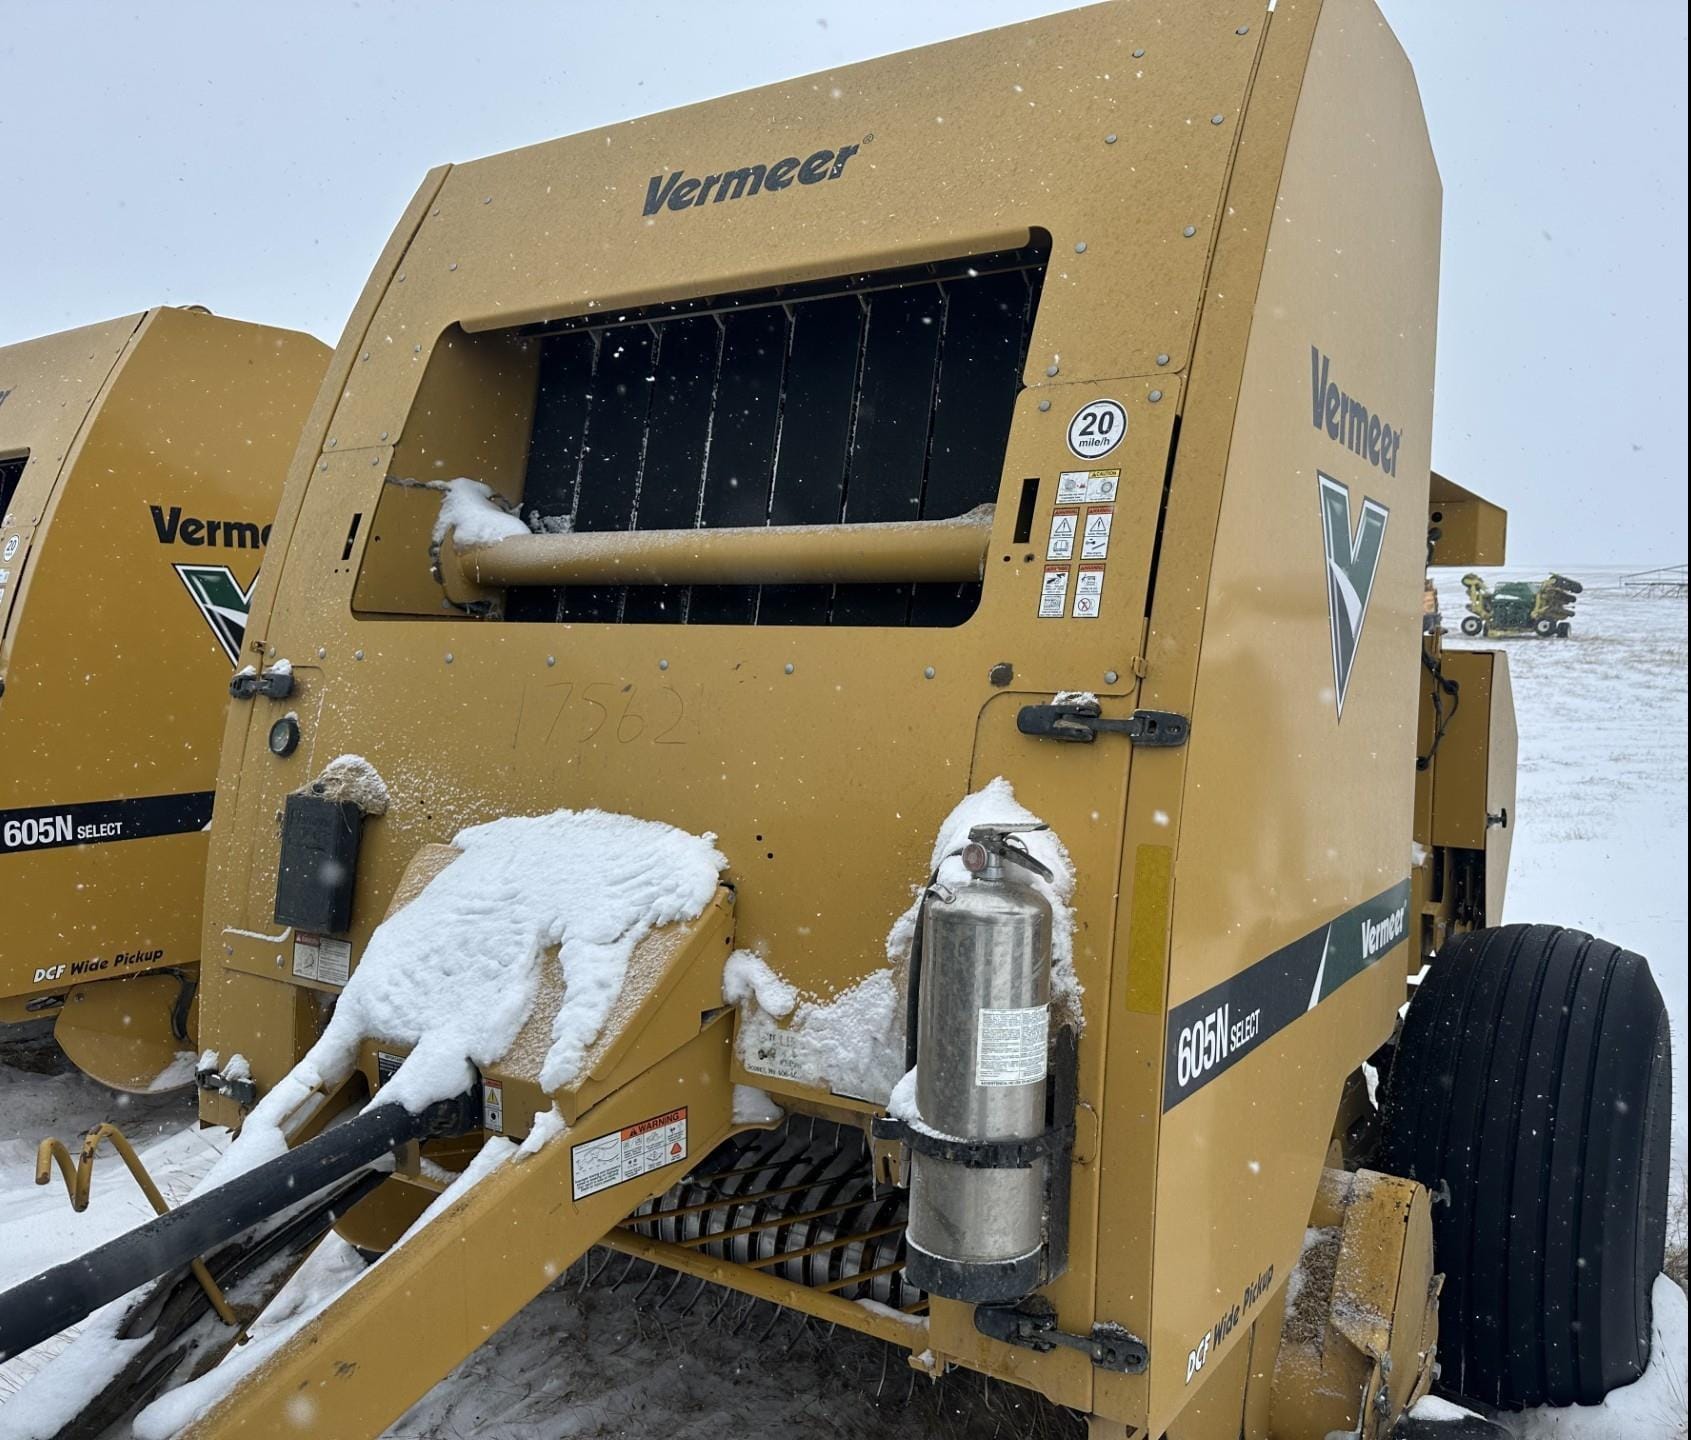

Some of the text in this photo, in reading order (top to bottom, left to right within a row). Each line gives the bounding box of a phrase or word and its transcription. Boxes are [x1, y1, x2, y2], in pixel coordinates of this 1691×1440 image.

[1079, 411, 1114, 436] 20
[1311, 344, 1401, 478] Vermeer
[1079, 437, 1110, 447] mile/h
[4, 814, 123, 847] 605N SELECT
[33, 949, 164, 983] DCF Wide Pickup
[1177, 1003, 1261, 1087] 605N SELECT
[639, 1112, 680, 1132] WARNING
[1185, 1264, 1274, 1386] DCF Wide Pickup
